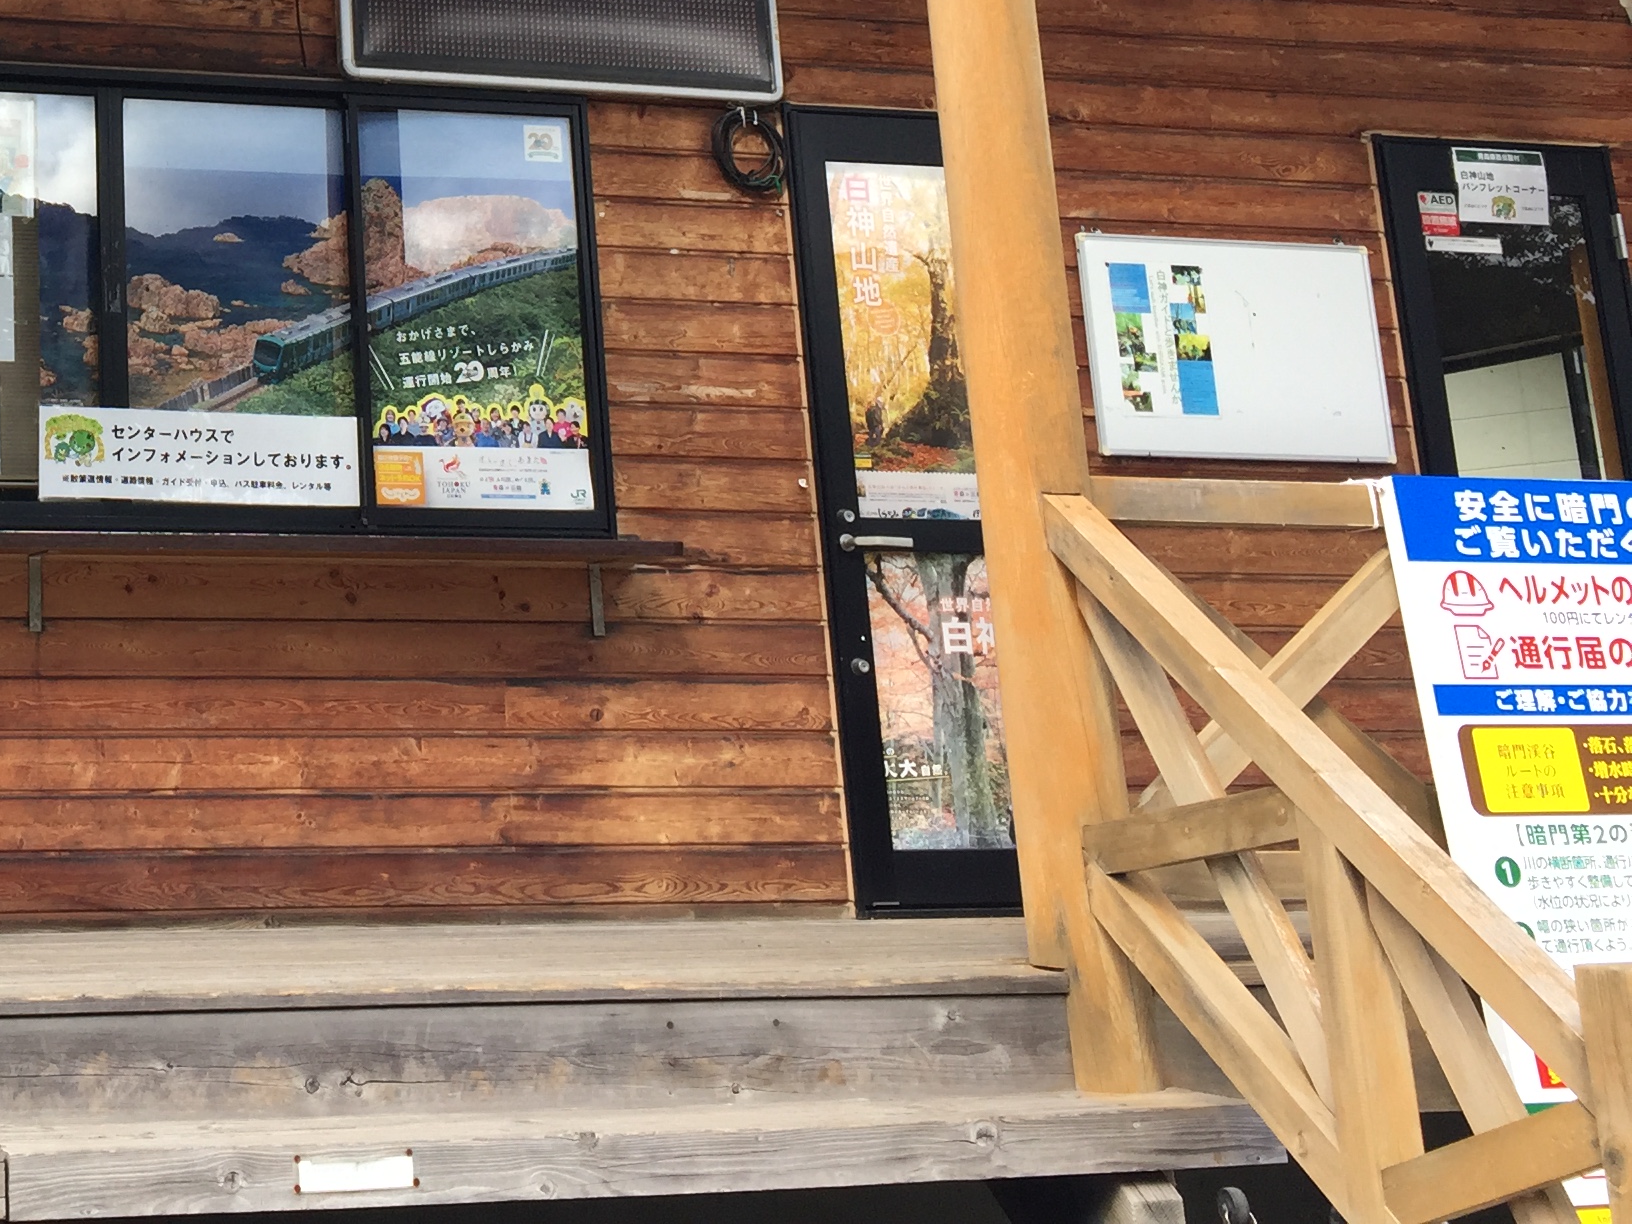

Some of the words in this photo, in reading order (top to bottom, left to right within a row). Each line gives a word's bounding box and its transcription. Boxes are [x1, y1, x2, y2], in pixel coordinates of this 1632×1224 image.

[1460, 171, 1494, 181] 白神山地
[1462, 183, 1545, 194] パンフレットコーナー
[1430, 195, 1454, 205] AED
[846, 173, 882, 307] 白神山地
[396, 325, 476, 343] おかげさまで、
[111, 425, 235, 444] センターハウスで
[111, 447, 353, 471] インフォメーションしております。
[571, 489, 587, 498] JR
[1454, 489, 1632, 525] 安全に暗門
[1499, 575, 1632, 606] ヘルメットの
[940, 597, 991, 612] 世界自
[1542, 611, 1632, 626] 100円にてレン
[1510, 635, 1632, 670] 通行届の
[1495, 688, 1632, 712] ご理解・ご協力
[1497, 743, 1555, 760] 暗門渓谷
[1506, 765, 1556, 778] ルートの
[1505, 783, 1565, 799] 注意事項
[1516, 823, 1632, 847] 【暗門第2の
[1536, 918, 1632, 933] 幅の狭い箇所が
